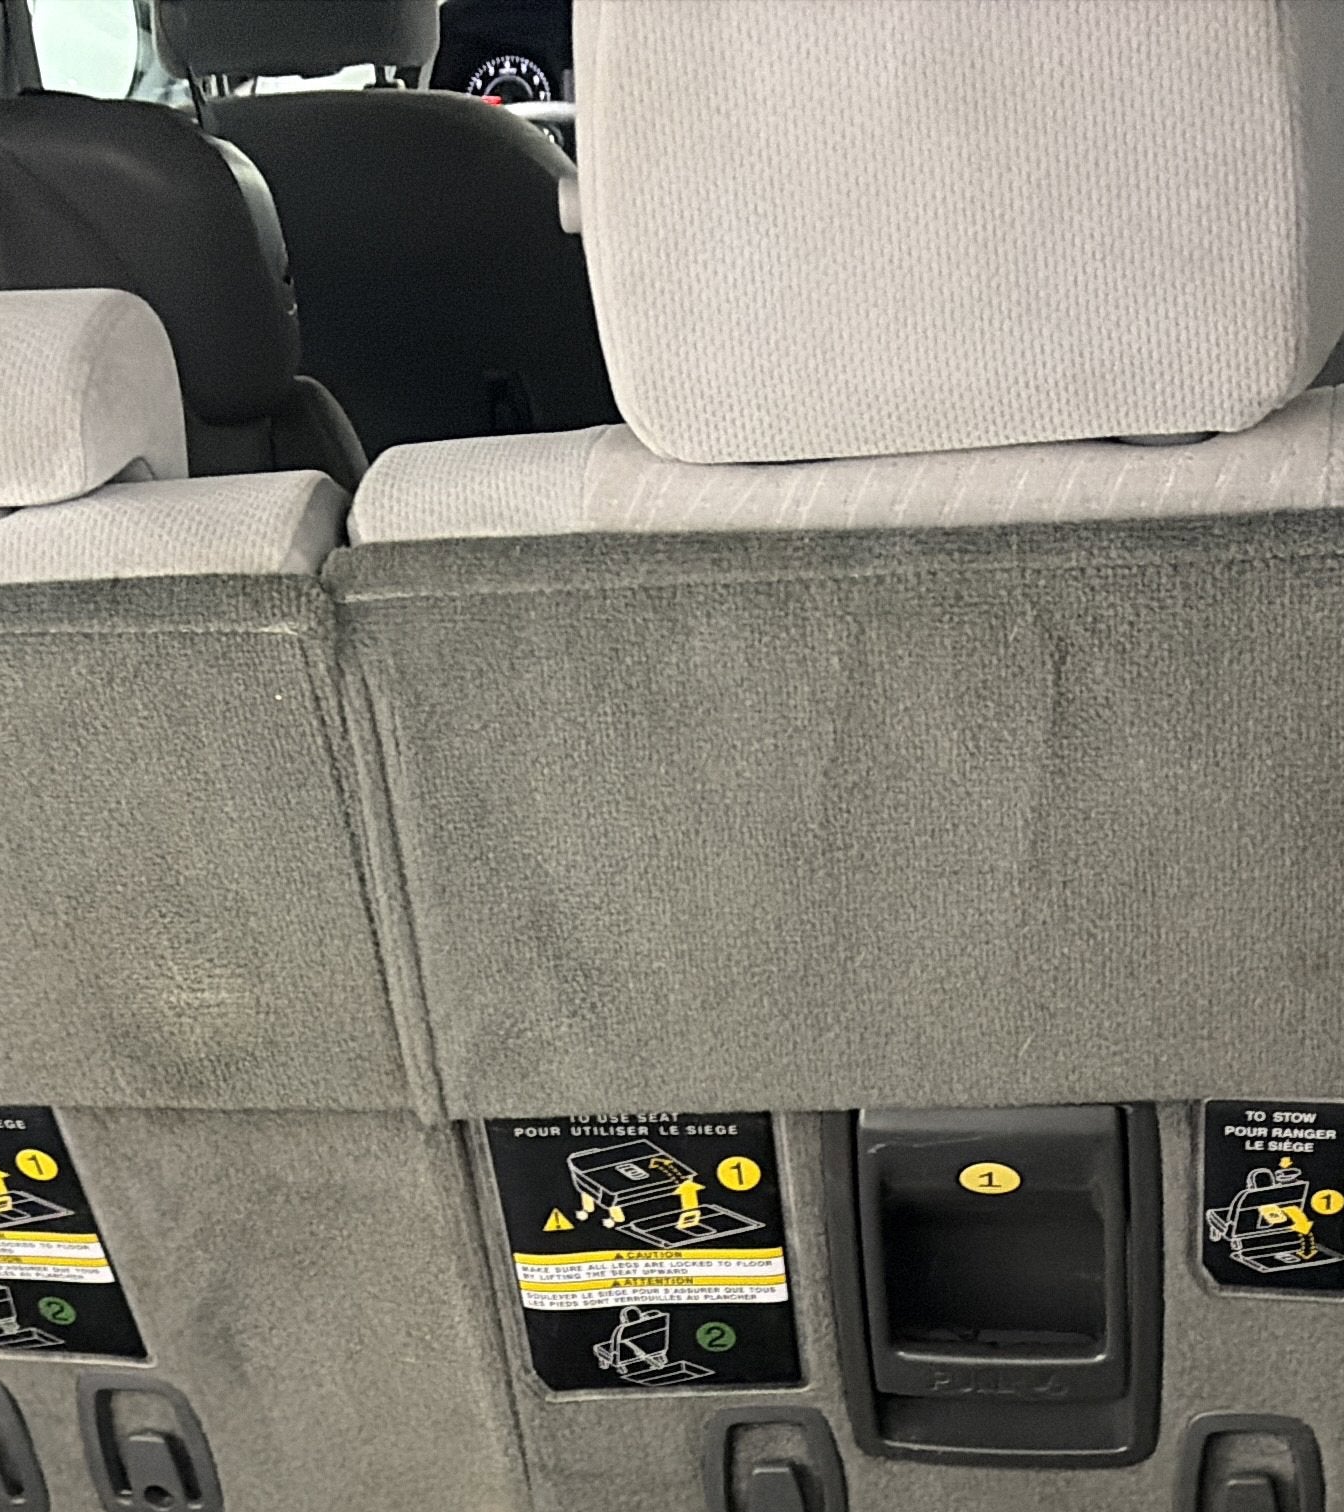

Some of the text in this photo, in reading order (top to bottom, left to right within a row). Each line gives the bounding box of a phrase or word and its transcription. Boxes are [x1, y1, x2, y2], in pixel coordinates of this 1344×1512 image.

[569, 1112, 679, 1124] TO USE SEAT
[1245, 1111, 1317, 1124] TO STOW
[513, 1127, 561, 1138] POUR
[570, 1125, 649, 1137] UTILISER
[658, 1125, 680, 1136] LE
[1224, 1125, 1337, 1140] POUR RANGER
[1244, 1139, 1265, 1151] LE
[626, 1251, 683, 1260] CAUTION
[521, 1266, 550, 1274] MAKE
[555, 1265, 582, 1273] SURE
[588, 1263, 608, 1271] ALL
[539, 1272, 582, 1281] LIFTING
[585, 1270, 606, 1278] THE
[611, 1269, 638, 1277] SEAT
[642, 1268, 688, 1276] UPWARD
[624, 1277, 694, 1286] ATTENTION
[549, 1300, 579, 1308] PIEDS
[583, 1298, 609, 1306] SONT
[703, 1293, 757, 1301] PLANCHER
[46, 1301, 69, 1322] 2
[705, 1326, 728, 1348] 2
